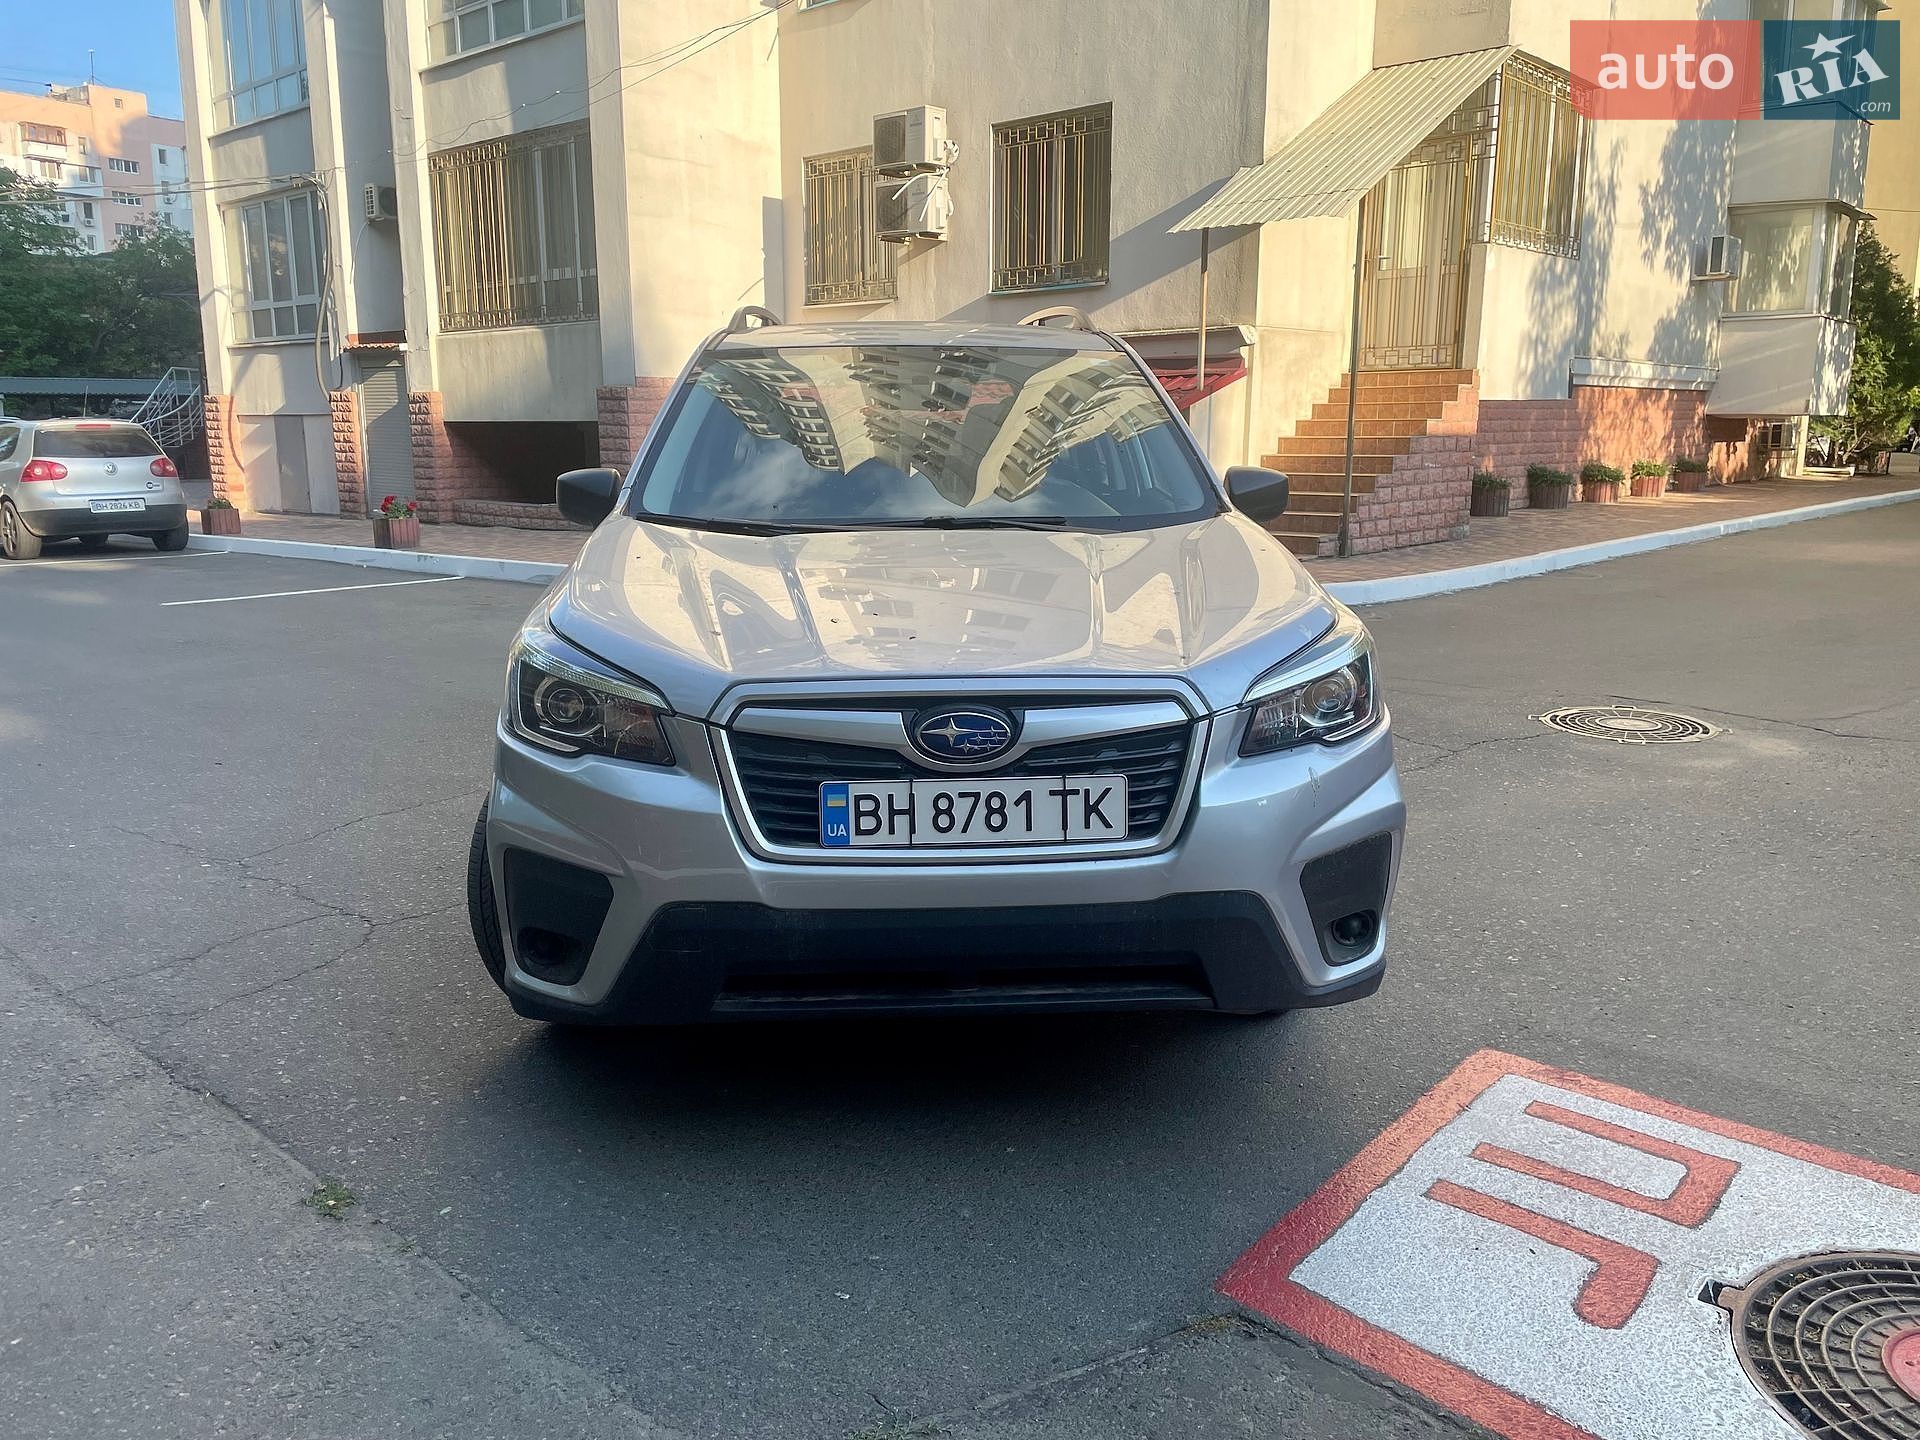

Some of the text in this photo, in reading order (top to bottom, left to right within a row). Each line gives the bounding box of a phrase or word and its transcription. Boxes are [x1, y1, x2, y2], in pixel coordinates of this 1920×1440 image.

[853, 787, 1114, 836] BH 8781 TK
[827, 824, 847, 837] UA
